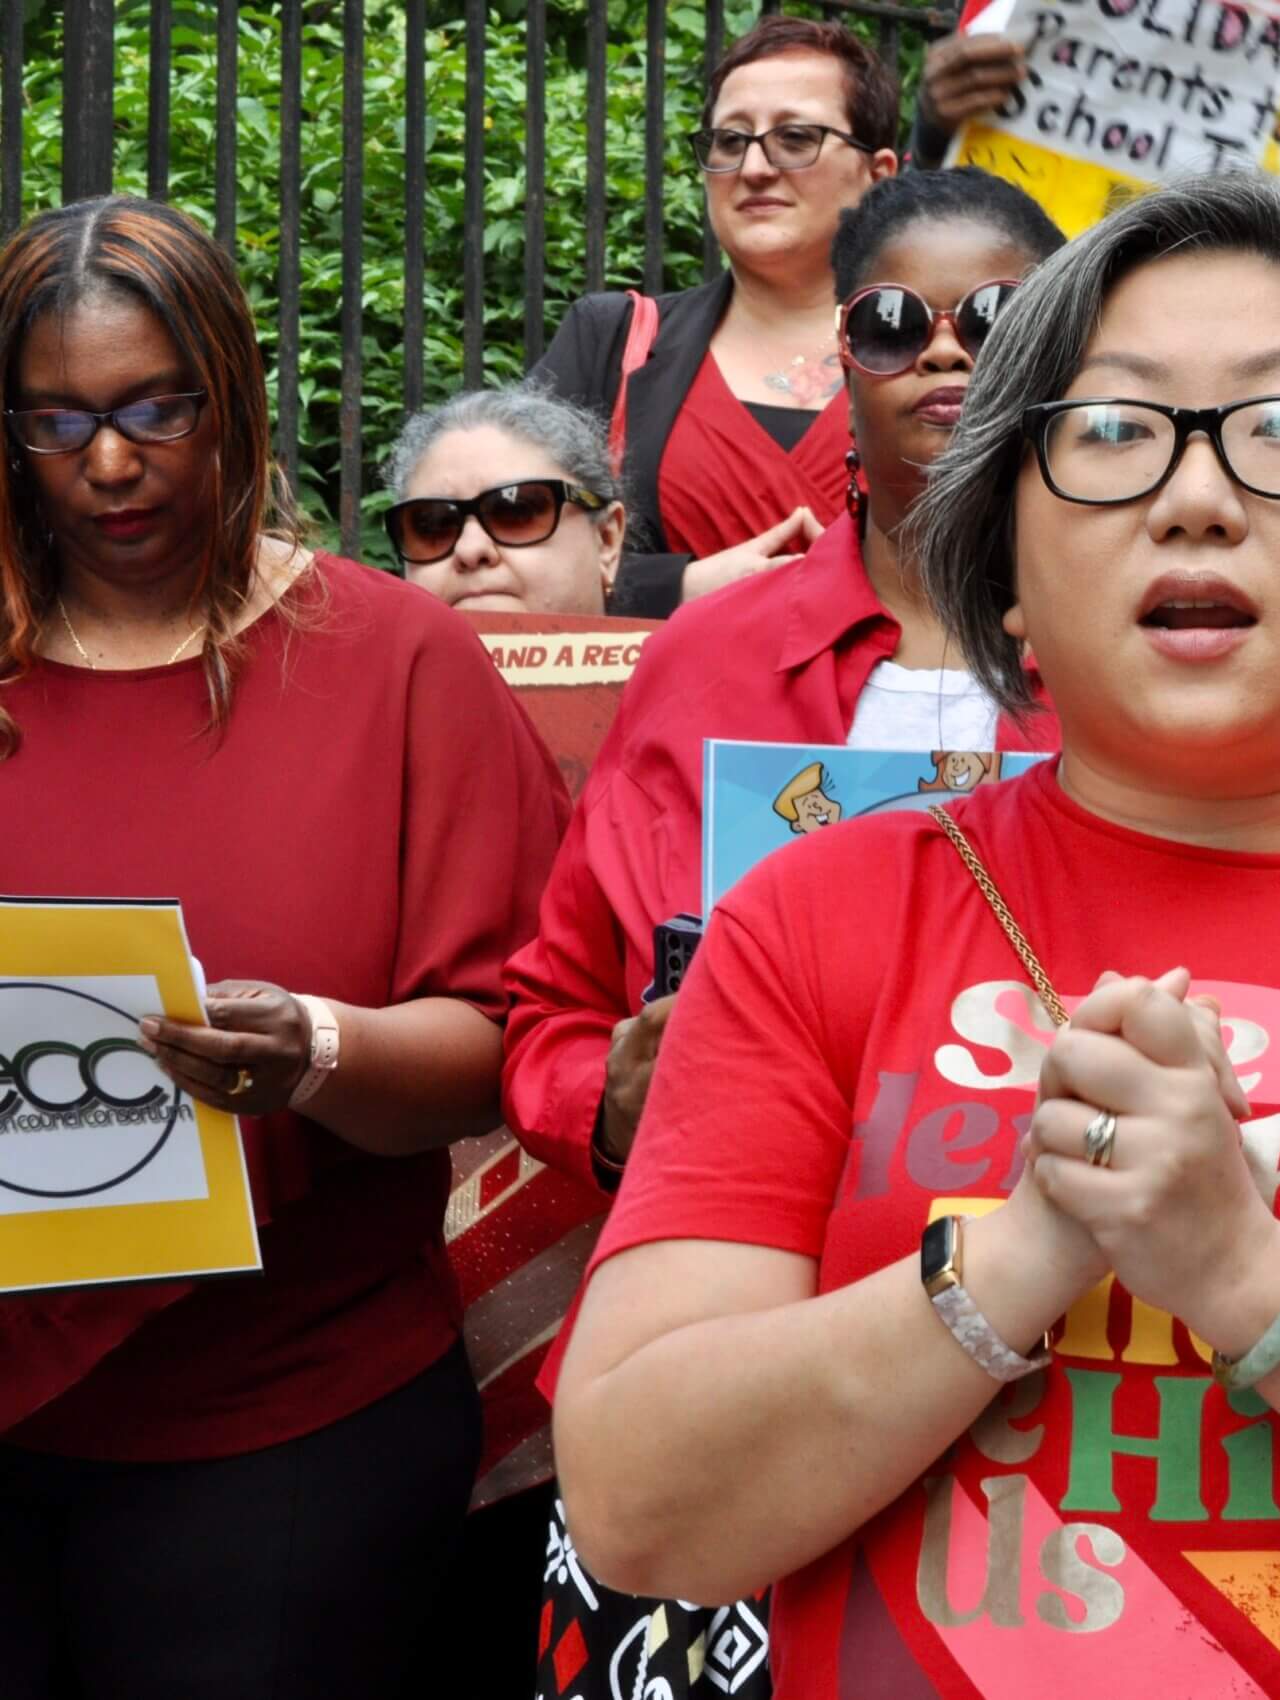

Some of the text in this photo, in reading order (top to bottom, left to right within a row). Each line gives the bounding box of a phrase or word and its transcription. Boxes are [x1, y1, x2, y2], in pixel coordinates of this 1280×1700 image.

[1024, 12, 1234, 119] Parents
[1000, 68, 1172, 168] School
[491, 645, 548, 669] AND
[552, 645, 574, 668] A
[916, 1472, 1127, 1634] Us
